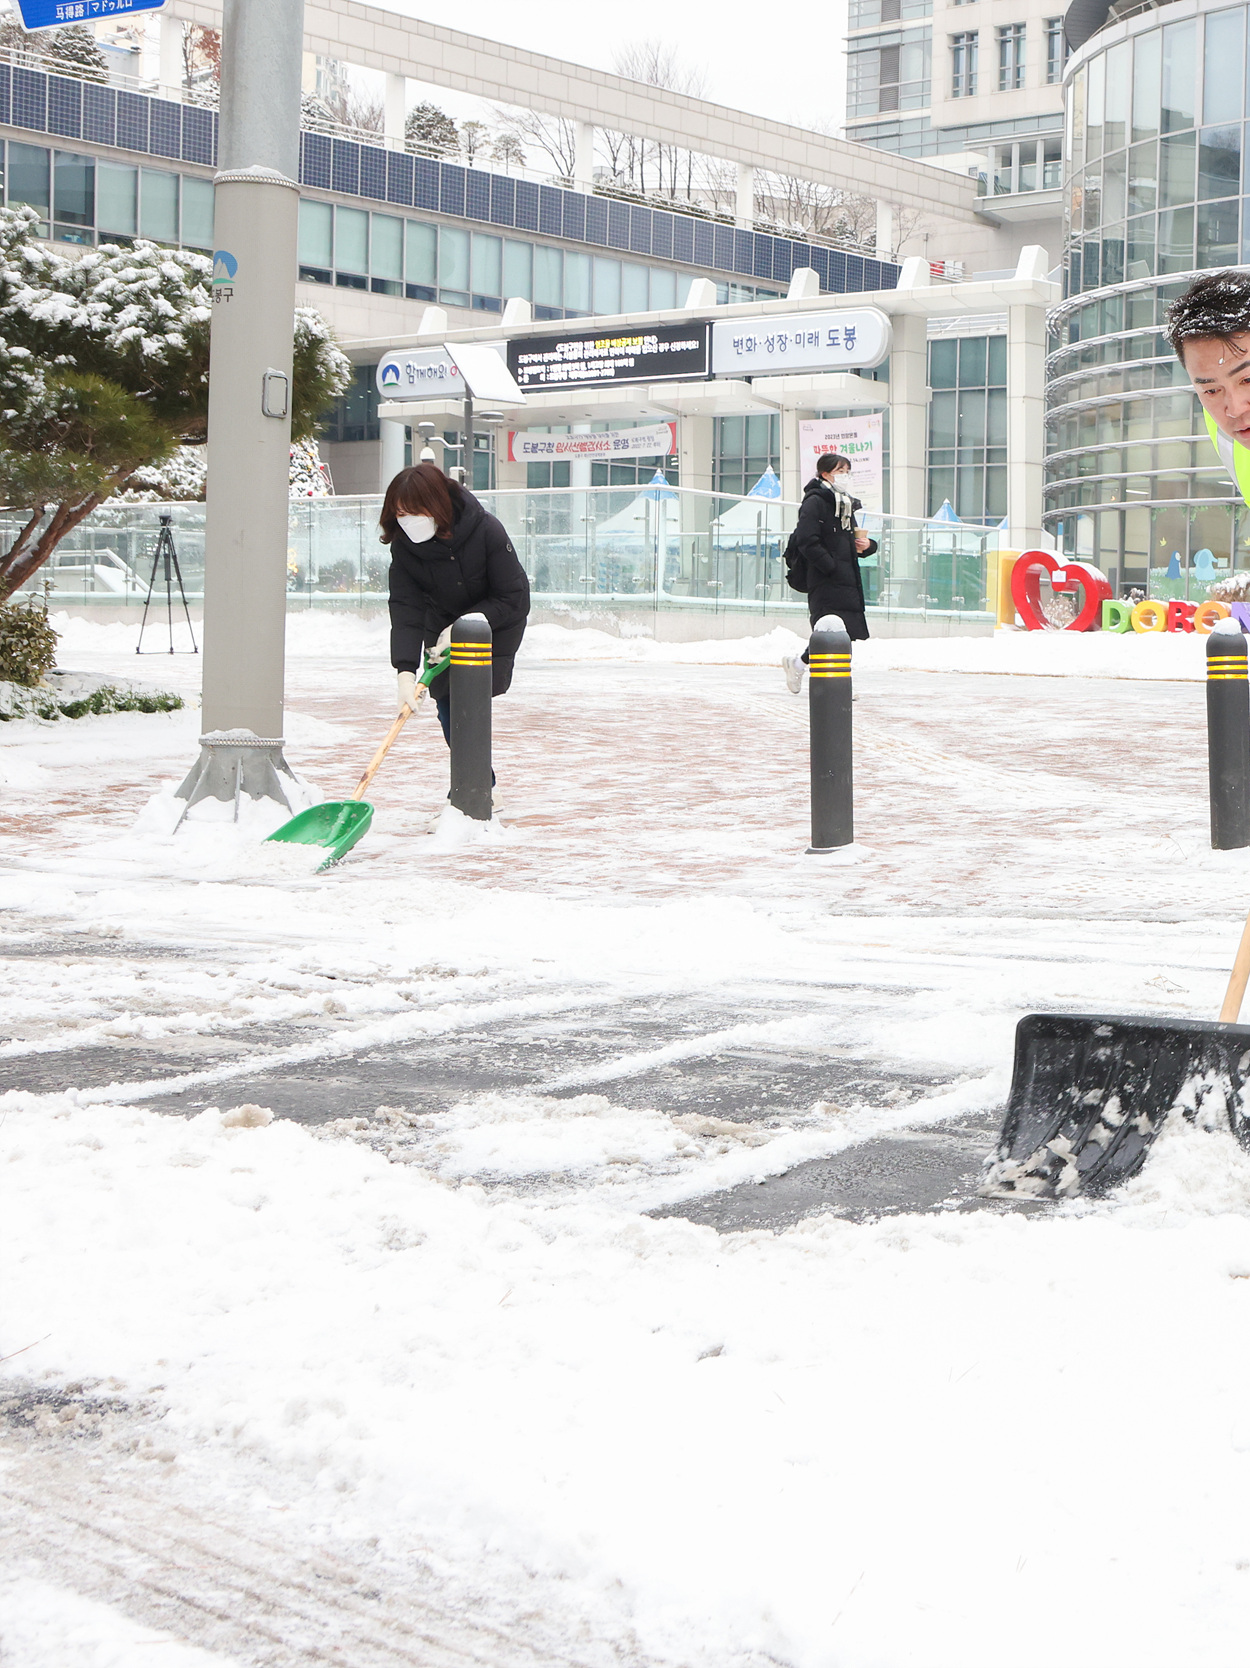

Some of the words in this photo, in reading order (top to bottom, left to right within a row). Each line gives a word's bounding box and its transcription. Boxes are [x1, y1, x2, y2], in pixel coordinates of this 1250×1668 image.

[55, 4, 85, 20] 马得路
[732, 331, 820, 355] 변화·성장·미래
[826, 326, 857, 351] 도봉
[405, 363, 448, 384] 함께해요!
[522, 441, 554, 454] 도봉구청
[555, 440, 611, 453] 임시선별검사소
[613, 438, 629, 450] 운영
[813, 444, 837, 455] 따뜻한
[840, 440, 873, 454] 겨울나기
